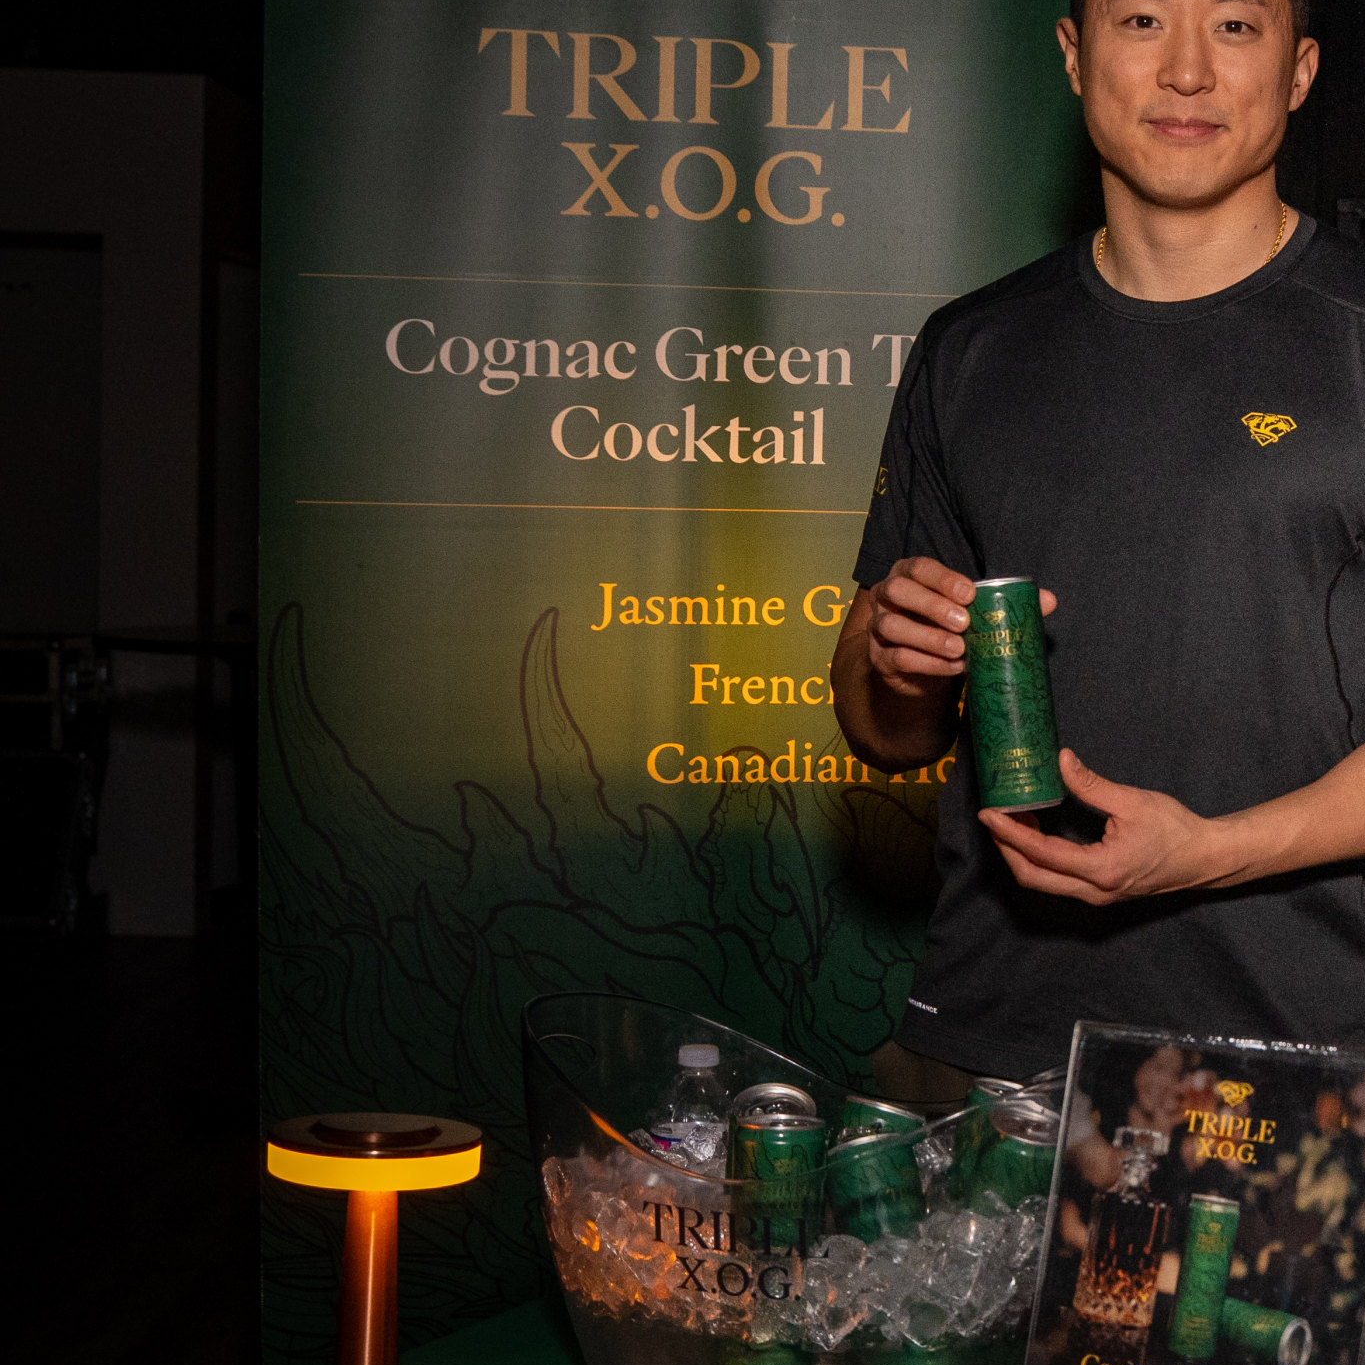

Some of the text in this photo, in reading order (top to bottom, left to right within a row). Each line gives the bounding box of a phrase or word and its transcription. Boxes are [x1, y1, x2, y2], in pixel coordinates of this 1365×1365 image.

[478, 28, 911, 133] TRIPLE
[560, 142, 845, 226] X.O.G.
[386, 319, 637, 395] Cognac
[655, 327, 853, 386] Green
[551, 404, 826, 465] Cocktail
[591, 583, 785, 631] Jasmine
[646, 740, 872, 784] Canadian
[1185, 1109, 1276, 1144] TRIPLE
[1198, 1137, 1257, 1165] X.O.G.
[676, 1255, 801, 1301] X.O.G.
